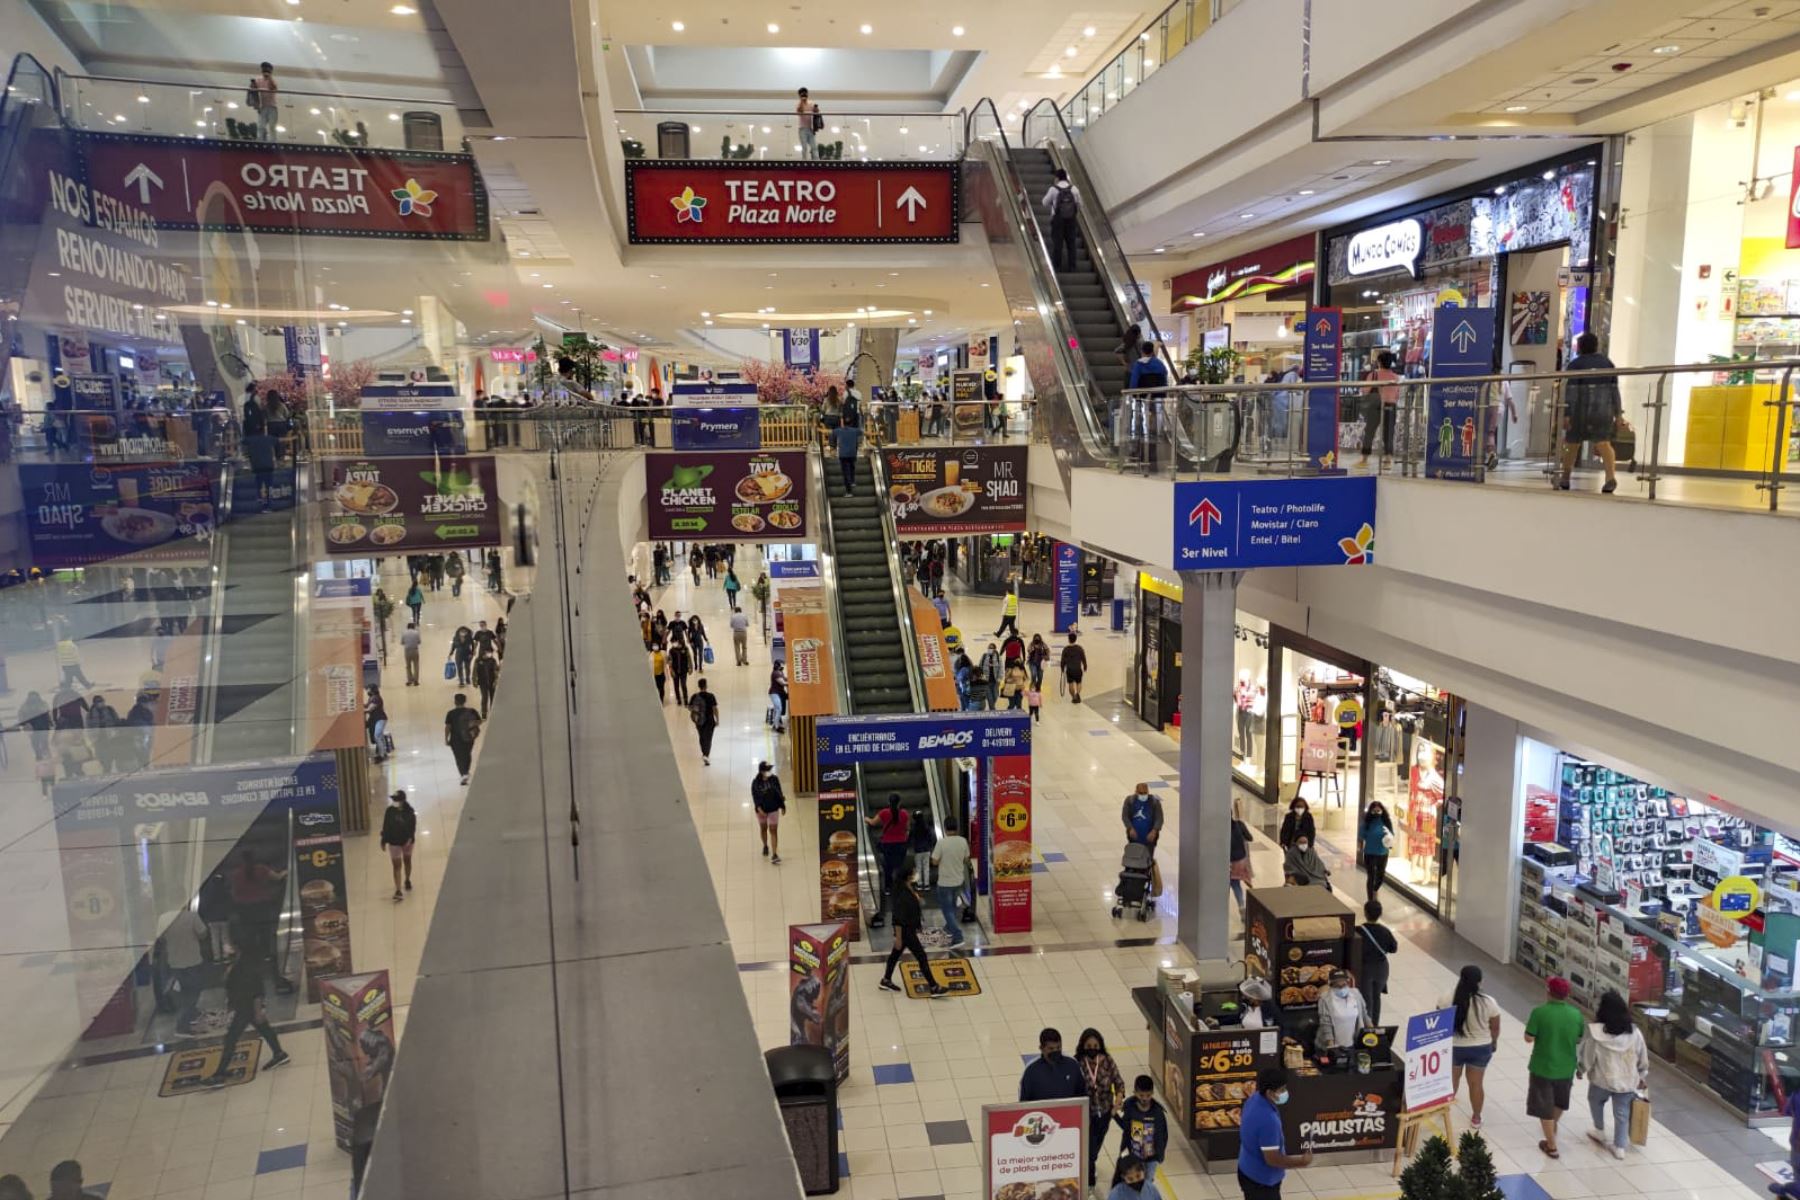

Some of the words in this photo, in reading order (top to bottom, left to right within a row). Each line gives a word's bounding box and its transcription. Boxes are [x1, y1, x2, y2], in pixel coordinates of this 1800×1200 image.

[724, 180, 836, 202] TEATRO
[50, 169, 91, 224] NOS
[93, 190, 159, 248] ESTAMOS
[728, 204, 780, 224] Plaza
[785, 205, 837, 223] Norte
[56, 228, 158, 293] RENOVANDO
[159, 264, 189, 302] PARA
[64, 285, 134, 336] SERVIRTE
[791, 337, 810, 347] V30
[700, 422, 738, 433] Prymera
[749, 460, 781, 474] TAYPÁ
[910, 460, 937, 473] TIGRE
[994, 461, 1014, 478] MR
[662, 488, 713, 497] PLANET
[986, 480, 1018, 502] SHAO
[661, 496, 717, 506] CHICKEN
[1251, 505, 1278, 514] Teatro
[1286, 503, 1326, 514] Photolife
[1251, 520, 1288, 529] Movistar
[1296, 519, 1319, 529] Claro
[1250, 535, 1273, 544] Entel
[1281, 534, 1301, 545] Bitel
[1182, 548, 1199, 558] 3er
[1201, 547, 1228, 558] Nivel
[801, 653, 810, 682] DONUTS
[918, 730, 974, 750] BEMBOS
[984, 728, 1013, 738] DELIVERY
[835, 745, 844, 754] EN
[845, 744, 852, 753] EL
[853, 744, 869, 754] PATIO
[870, 743, 880, 752] DE
[1425, 1016, 1440, 1030] W
[1200, 1049, 1253, 1072] S/6.90
[1420, 1051, 1440, 1077] 10
[1300, 1118, 1386, 1137] PAULISTAS
[997, 1158, 1007, 1166] La
[1009, 1156, 1034, 1165] mejor
[1036, 1152, 1075, 1161] variedad
[1000, 1166, 1011, 1174] de
[1013, 1164, 1039, 1174] platos
[1051, 1161, 1073, 1171] peso
